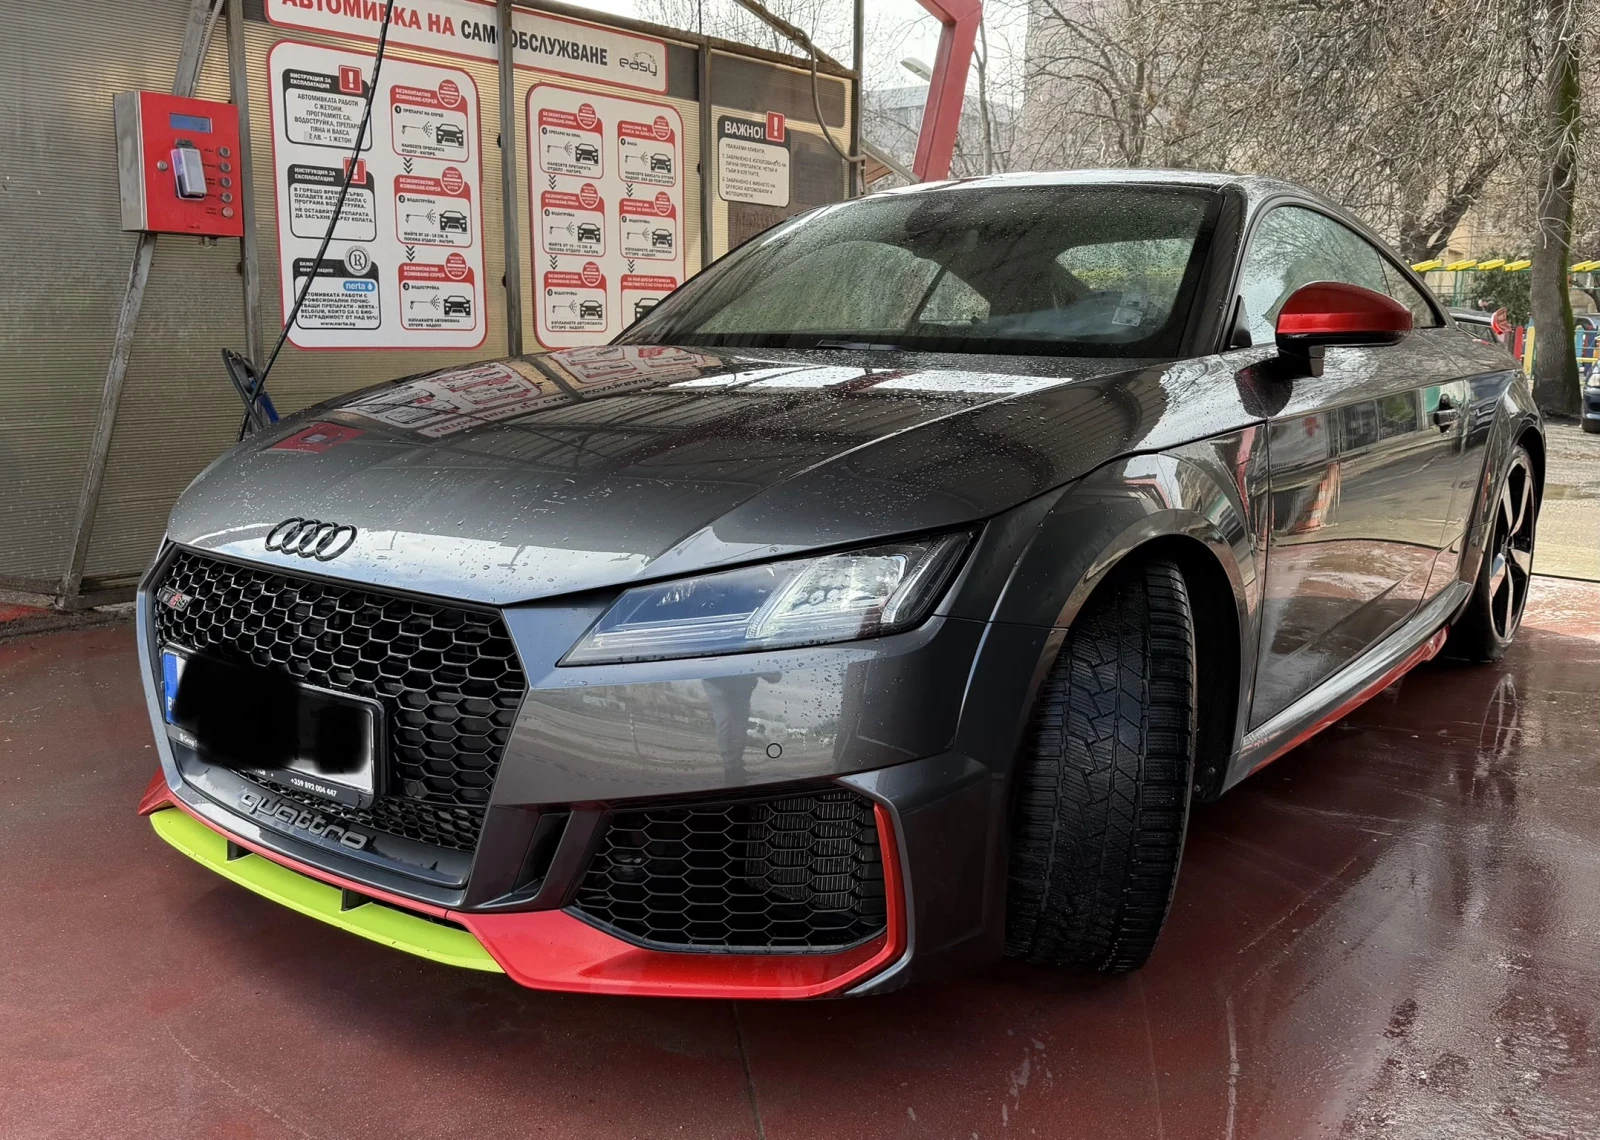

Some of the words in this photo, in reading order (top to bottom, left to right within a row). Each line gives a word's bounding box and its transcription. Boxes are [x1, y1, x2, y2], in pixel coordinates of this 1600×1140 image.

[428, 12, 456, 36] НА
[461, 20, 608, 66] САМОБСЛУЖВАНЕ
[619, 57, 658, 76] easy
[290, 72, 324, 82] ИНСТРУКЦИЯ
[290, 78, 330, 89] ЕКСПЛОАТАЦИЯ
[298, 93, 337, 104] АВТОМИВКАТА
[338, 98, 358, 107] РАБОТИ
[319, 104, 344, 112] ЖЕТОНИ.
[306, 110, 342, 120] ПРОГРАМИТЕ
[294, 116, 335, 128] ВОДОСТРУЙКА,
[336, 121, 362, 130] ПРЕПАРА
[332, 128, 350, 136] ВАКСА
[725, 121, 764, 139] ВАЖНО!
[333, 136, 352, 144] ЖЕТОН
[726, 154, 748, 162] ЗАБРАНЕНО
[726, 177, 748, 185] ЗАБРАНЕНО
[326, 201, 366, 209] ВОДСТРУЙКА,
[291, 778, 304, 787] +359
[305, 782, 315, 790] 892
[315, 785, 325, 793] 004
[327, 788, 337, 797] 447
[240, 792, 368, 850] quattro
